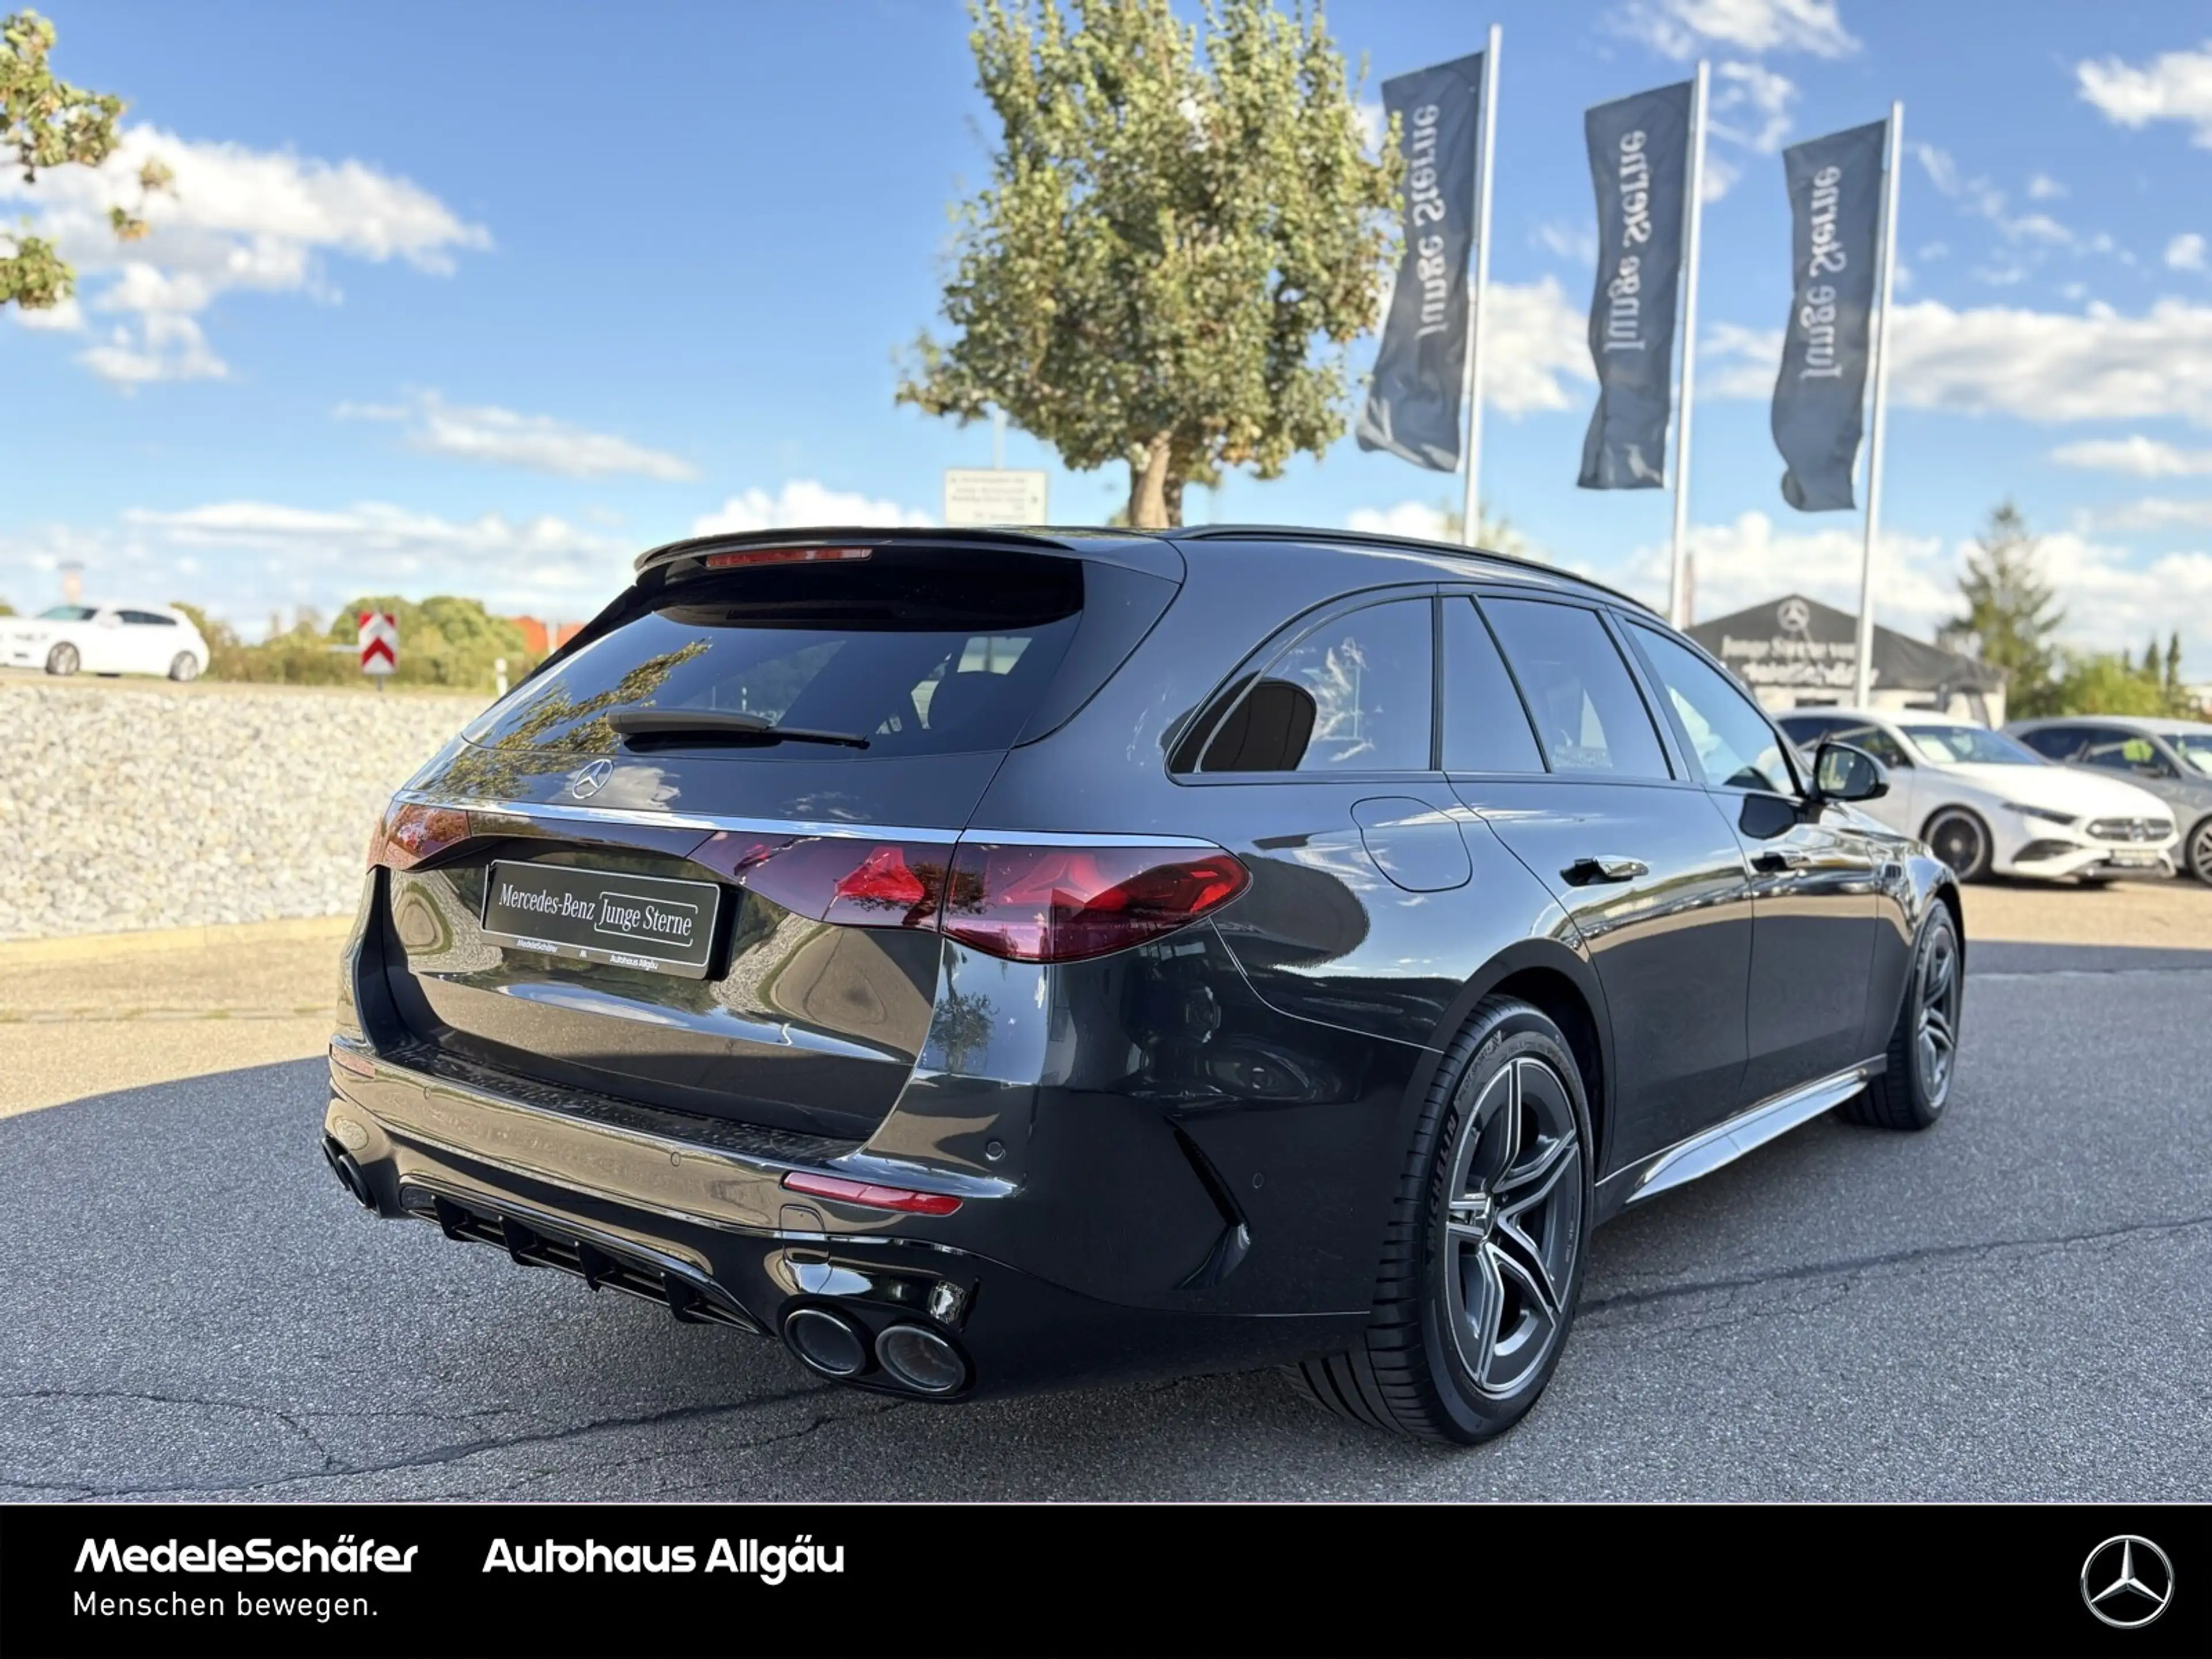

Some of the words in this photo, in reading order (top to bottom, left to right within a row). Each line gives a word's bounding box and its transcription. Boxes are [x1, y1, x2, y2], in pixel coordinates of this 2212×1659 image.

[498, 882, 596, 921] Mercedes-Benz
[599, 898, 642, 932] Junge
[642, 904, 693, 937] Sterne
[1426, 1113, 1458, 1252] MICHELIN
